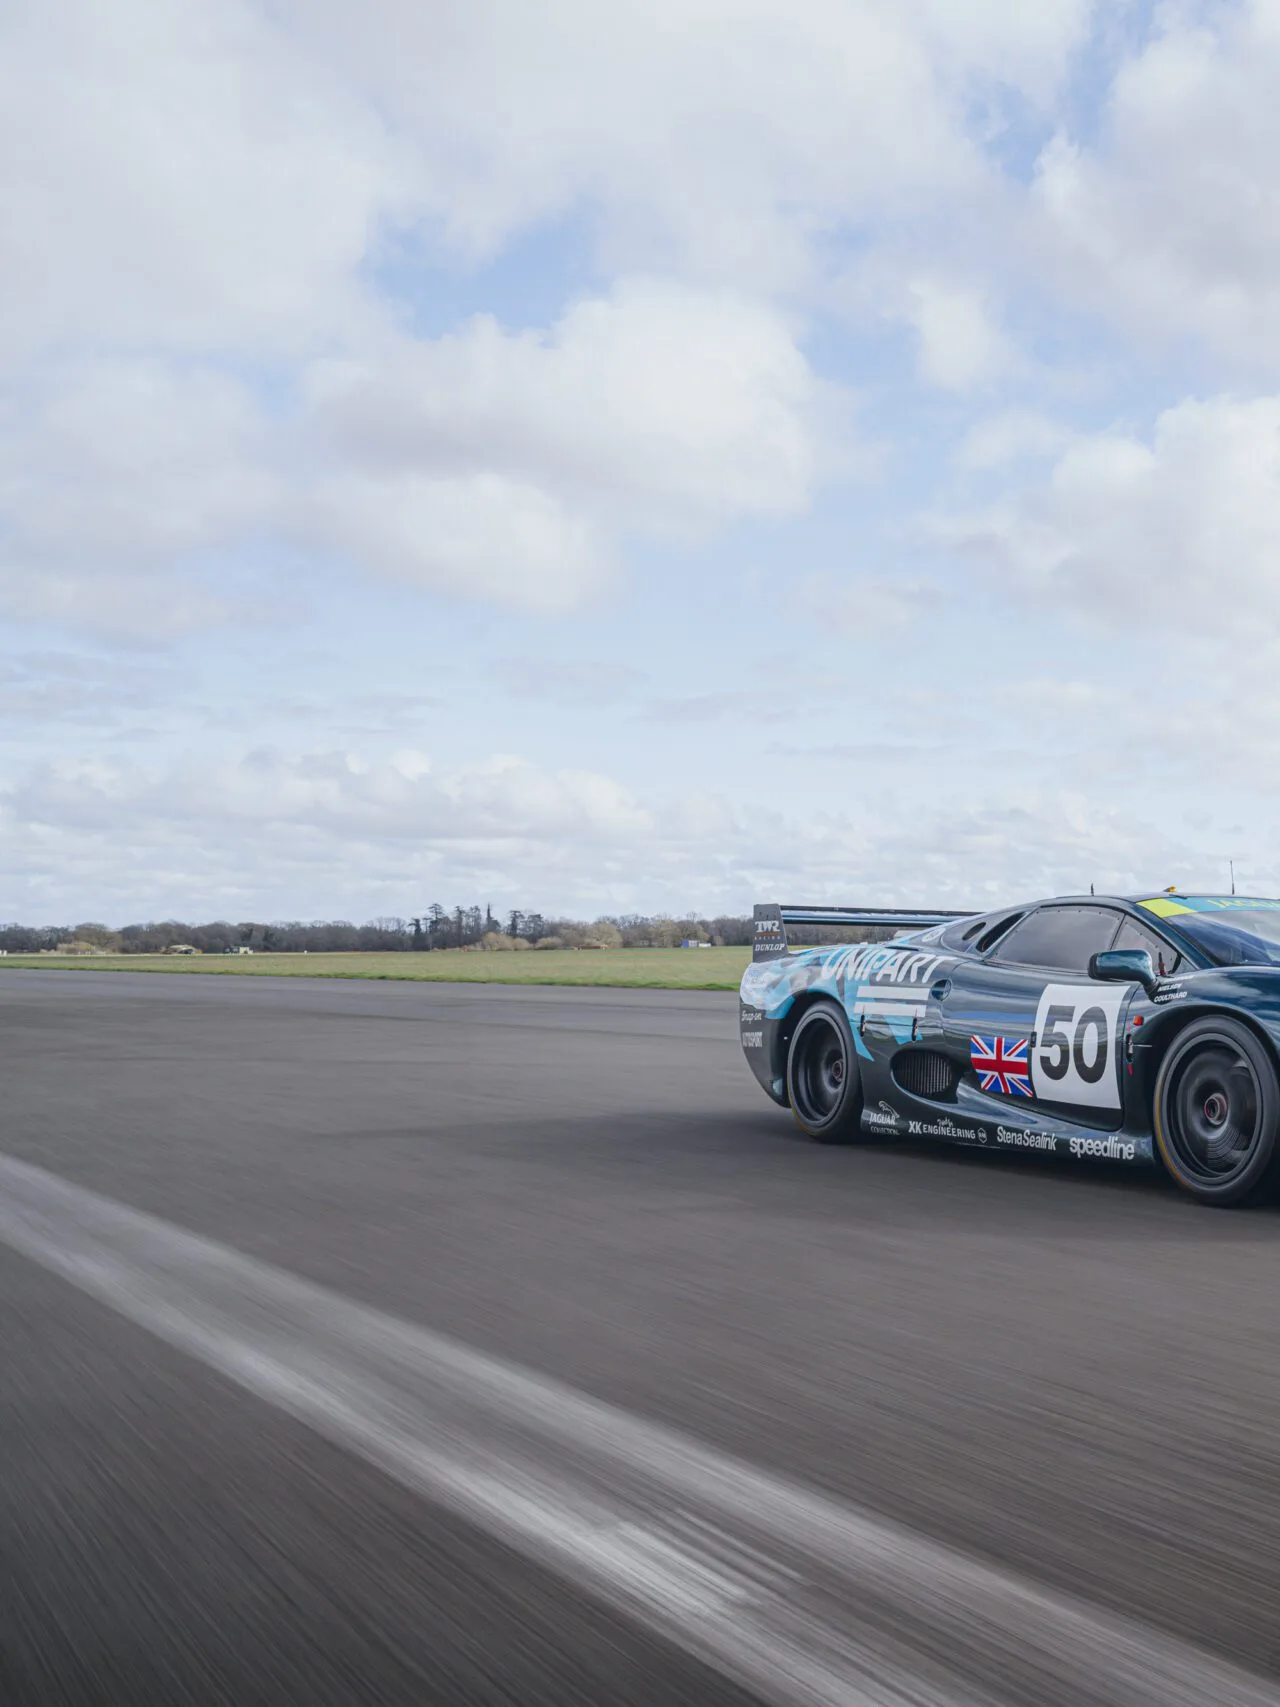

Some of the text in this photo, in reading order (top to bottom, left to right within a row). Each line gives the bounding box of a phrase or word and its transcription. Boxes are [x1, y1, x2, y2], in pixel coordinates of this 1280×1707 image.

[755, 921, 780, 933] TWR
[755, 943, 785, 951] DUNLOP
[820, 948, 958, 984] UNIPART
[1040, 1004, 1108, 1084] 50
[869, 1112, 896, 1124] JAGUAR
[908, 1120, 922, 1134] XK
[922, 1124, 976, 1139] ENGINEERING
[1069, 1136, 1135, 1160] speedline
